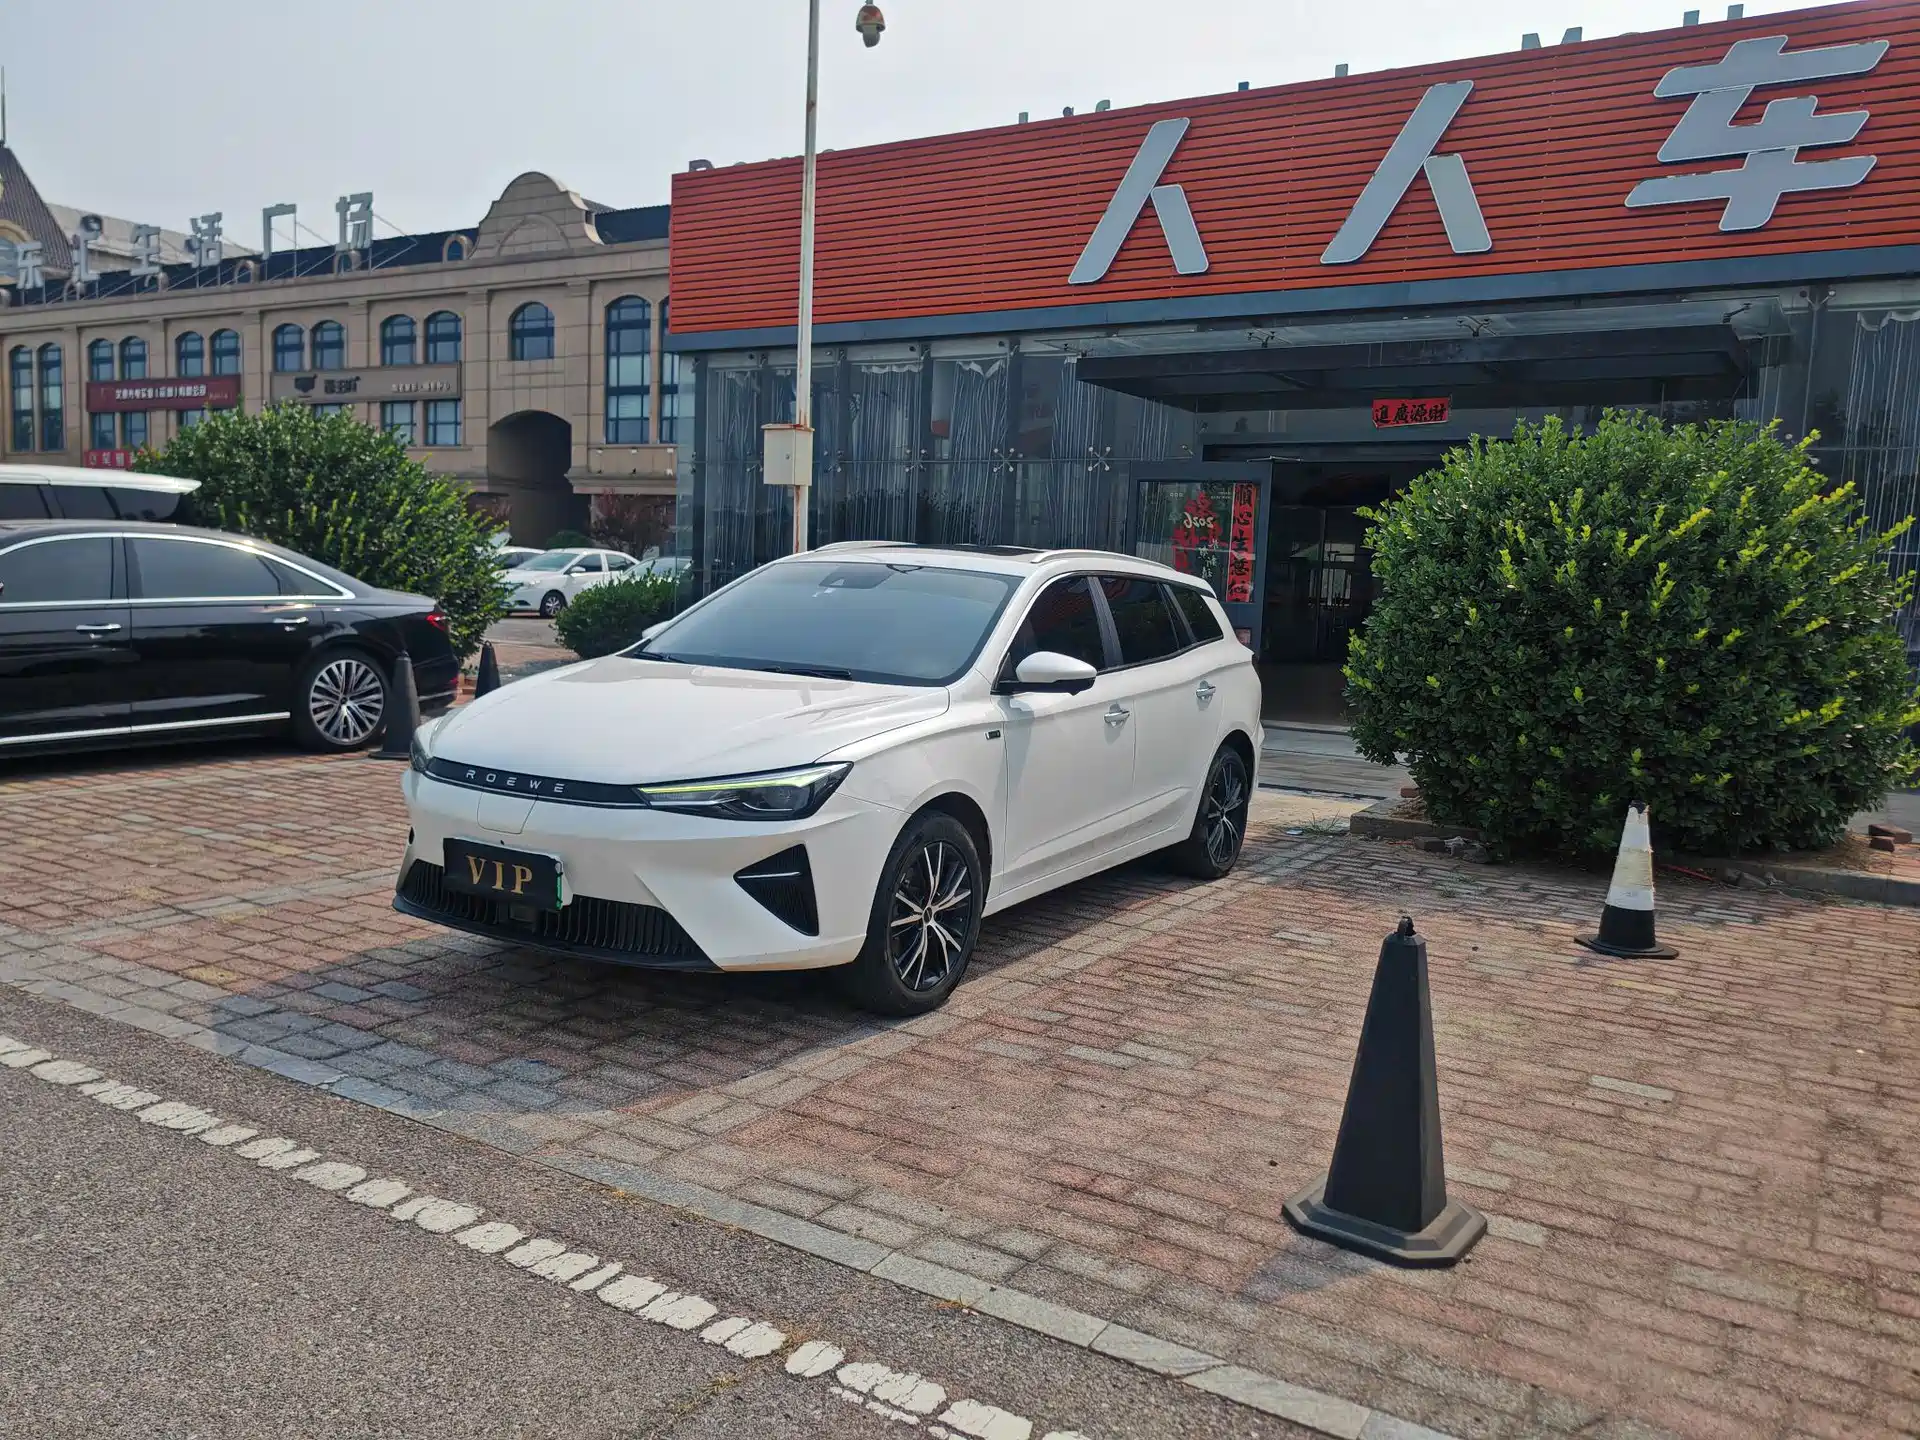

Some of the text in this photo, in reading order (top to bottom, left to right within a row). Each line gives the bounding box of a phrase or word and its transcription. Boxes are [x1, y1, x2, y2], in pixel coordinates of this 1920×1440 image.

[1068, 34, 1890, 285] 人人车
[465, 769, 565, 793] ROEWE
[465, 855, 533, 895] VIP
